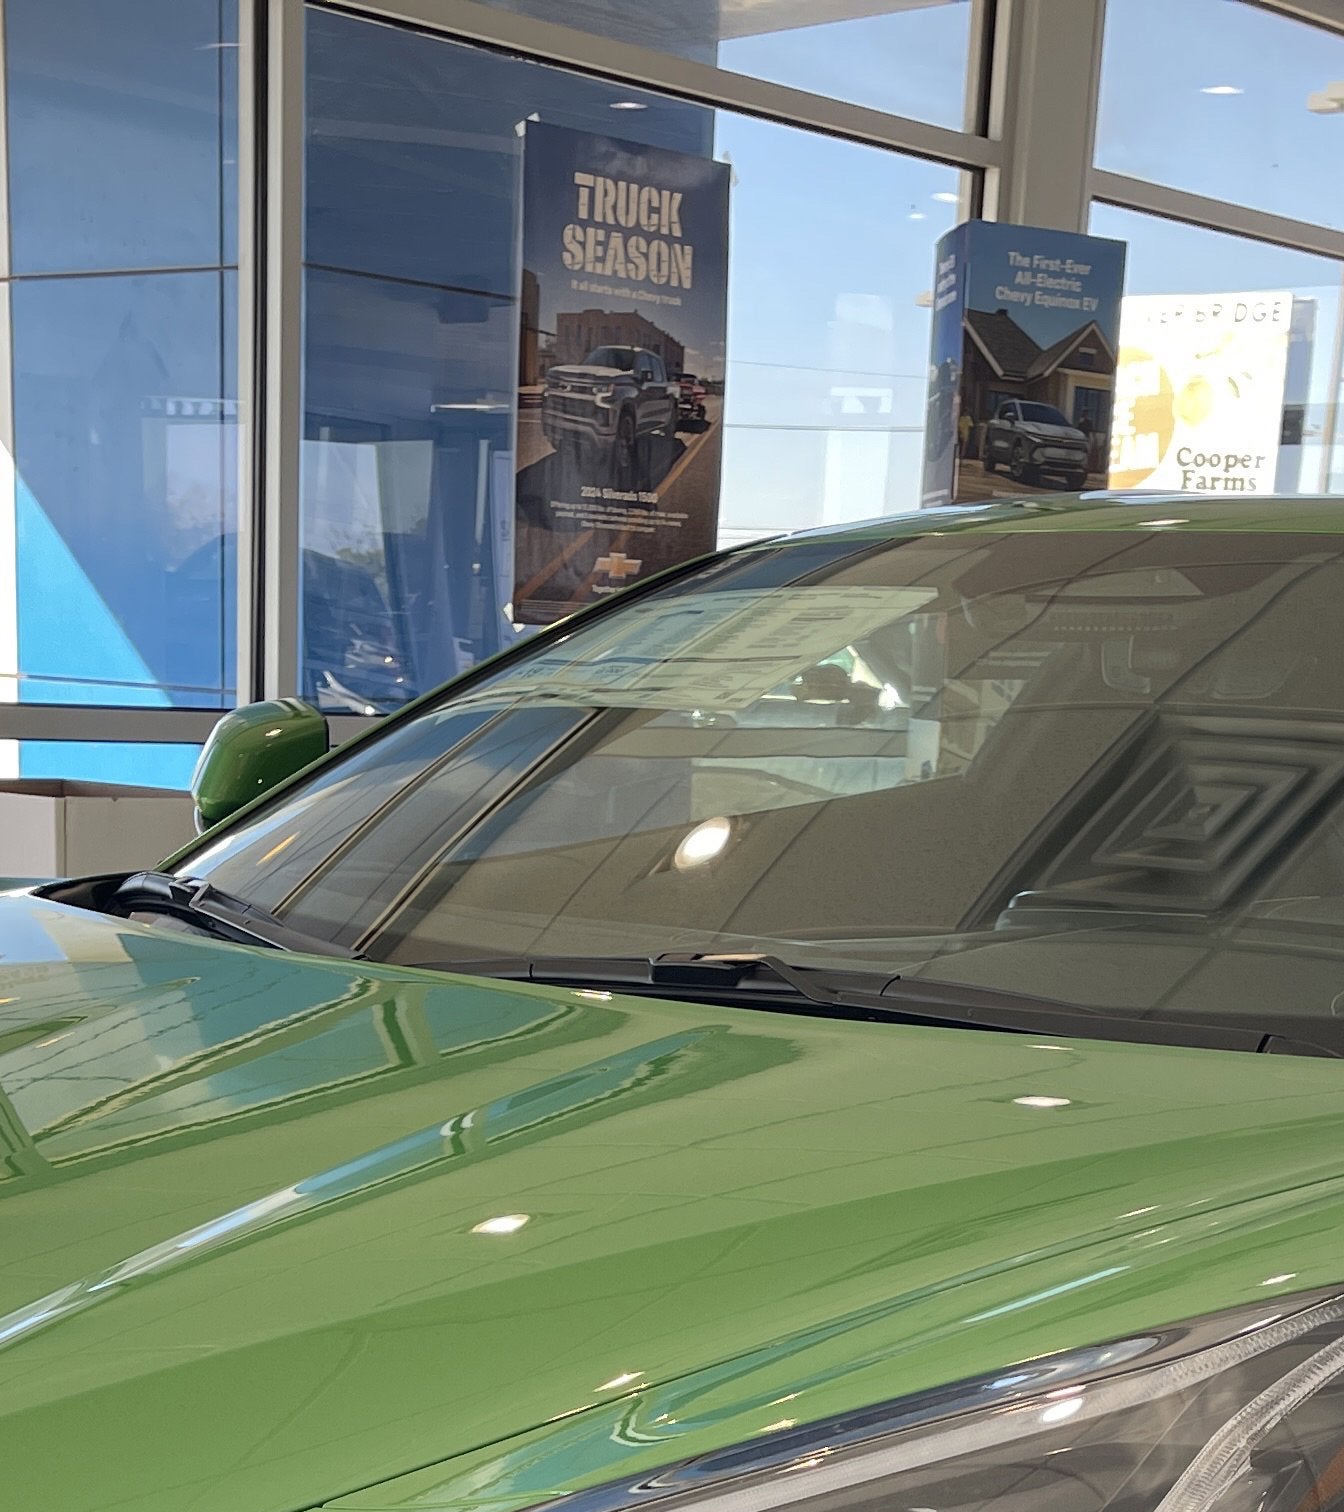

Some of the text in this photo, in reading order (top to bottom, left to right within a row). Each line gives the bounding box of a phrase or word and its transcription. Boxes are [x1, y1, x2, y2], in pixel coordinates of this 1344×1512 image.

[574, 171, 683, 237] TRUCK
[562, 224, 694, 289] SEASON
[1176, 446, 1266, 472] Cooper
[1181, 470, 1257, 491] Farms
